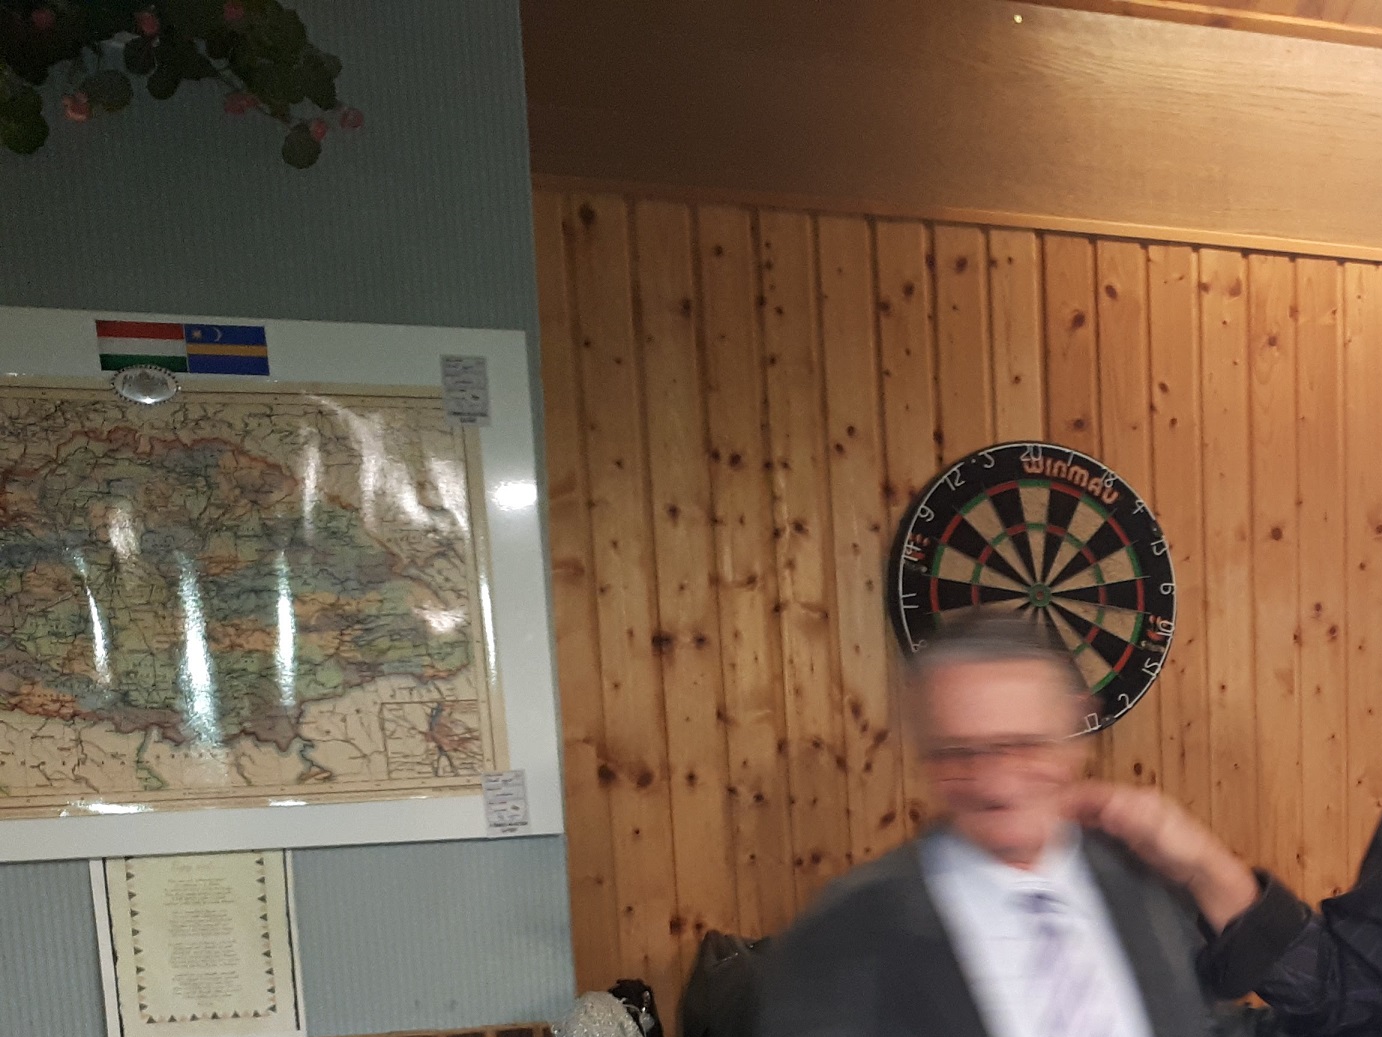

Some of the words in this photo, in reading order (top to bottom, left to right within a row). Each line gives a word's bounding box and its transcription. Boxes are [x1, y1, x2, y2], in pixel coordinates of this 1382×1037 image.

[1020, 445, 1042, 461] 20
[943, 468, 966, 491] 12
[918, 505, 935, 522] 9
[902, 542, 921, 561] 14
[1157, 620, 1174, 637] 10
